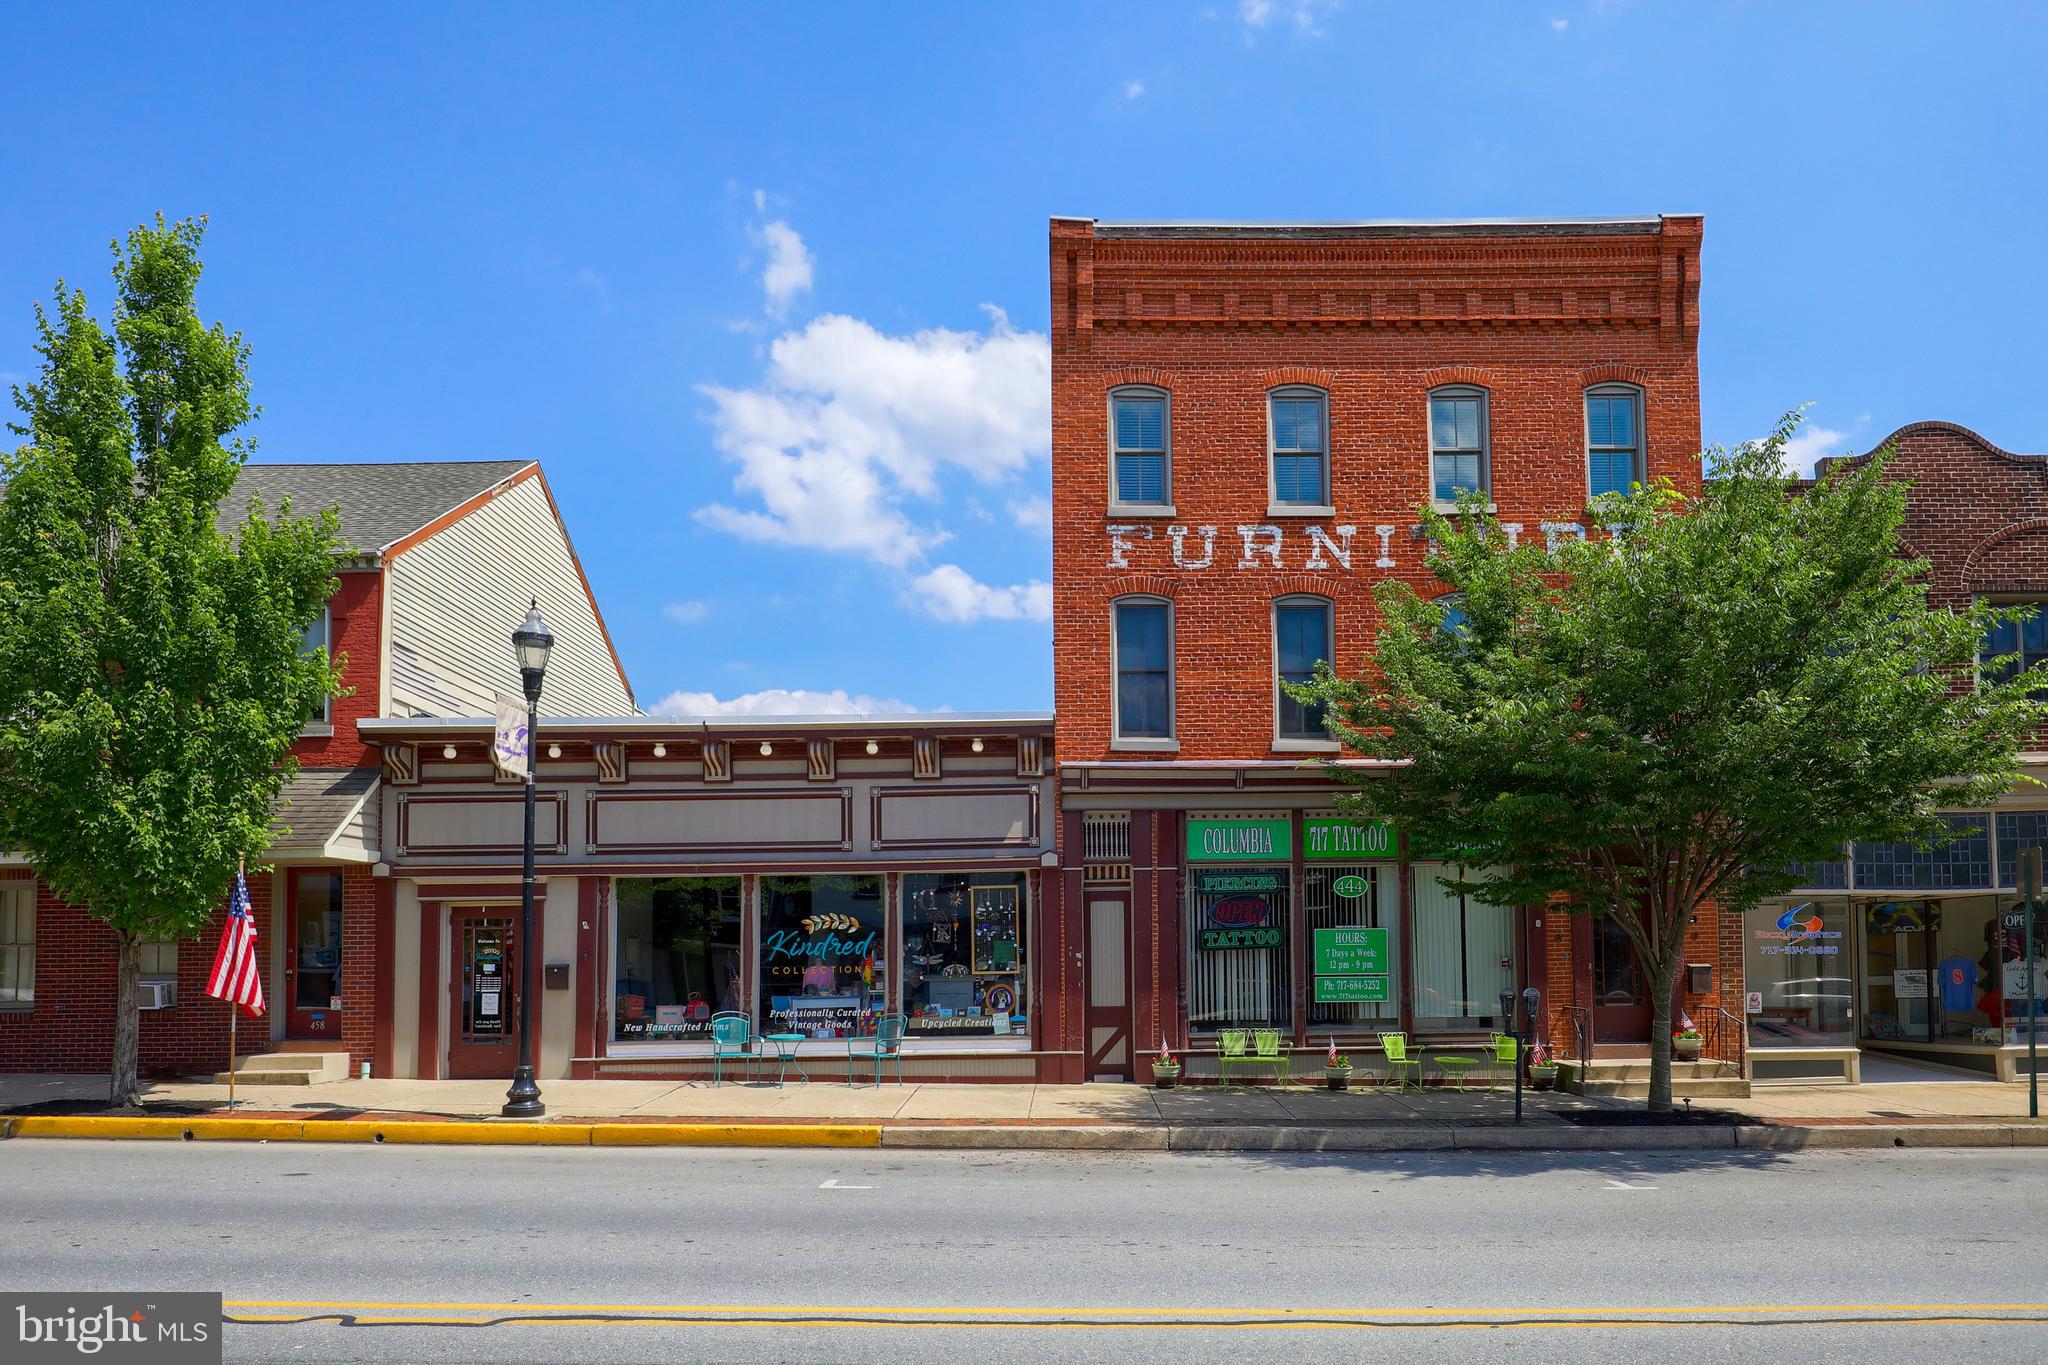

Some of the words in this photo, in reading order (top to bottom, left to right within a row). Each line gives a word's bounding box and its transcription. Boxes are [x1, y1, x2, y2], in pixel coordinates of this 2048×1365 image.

[1105, 522, 1642, 570] FURNIR
[1203, 828, 1273, 854] COLUMBIA
[1309, 826, 1328, 851] 717
[1332, 825, 1388, 852] TATTOO
[1204, 877, 1278, 891] PIERCING
[1337, 880, 1362, 893] 444
[2005, 914, 2025, 927] OPE
[1204, 930, 1280, 947] TATTOO
[1335, 932, 1368, 944] HOURS:
[767, 930, 876, 961] Kindred
[1326, 949, 1330, 957] 7
[1332, 949, 1349, 959] Days
[1357, 949, 1377, 957] Week:
[772, 965, 871, 975] COLLECTIONS
[1330, 961, 1337, 969] 12
[1338, 963, 1350, 971] pm
[1356, 961, 1361, 969] 9
[1362, 963, 1374, 971] pm
[1324, 981, 1335, 990] Ph:
[1336, 980, 1380, 990] 717-684-5252
[769, 1008, 834, 1019] Professionally
[836, 1008, 871, 1017] Curated
[311, 1021, 325, 1030] 458
[624, 1023, 643, 1032] New
[645, 1022, 701, 1033] Handcrafted
[788, 1021, 822, 1030] Vintage
[825, 1020, 852, 1029] Goods
[921, 1019, 961, 1029] Upcycled
